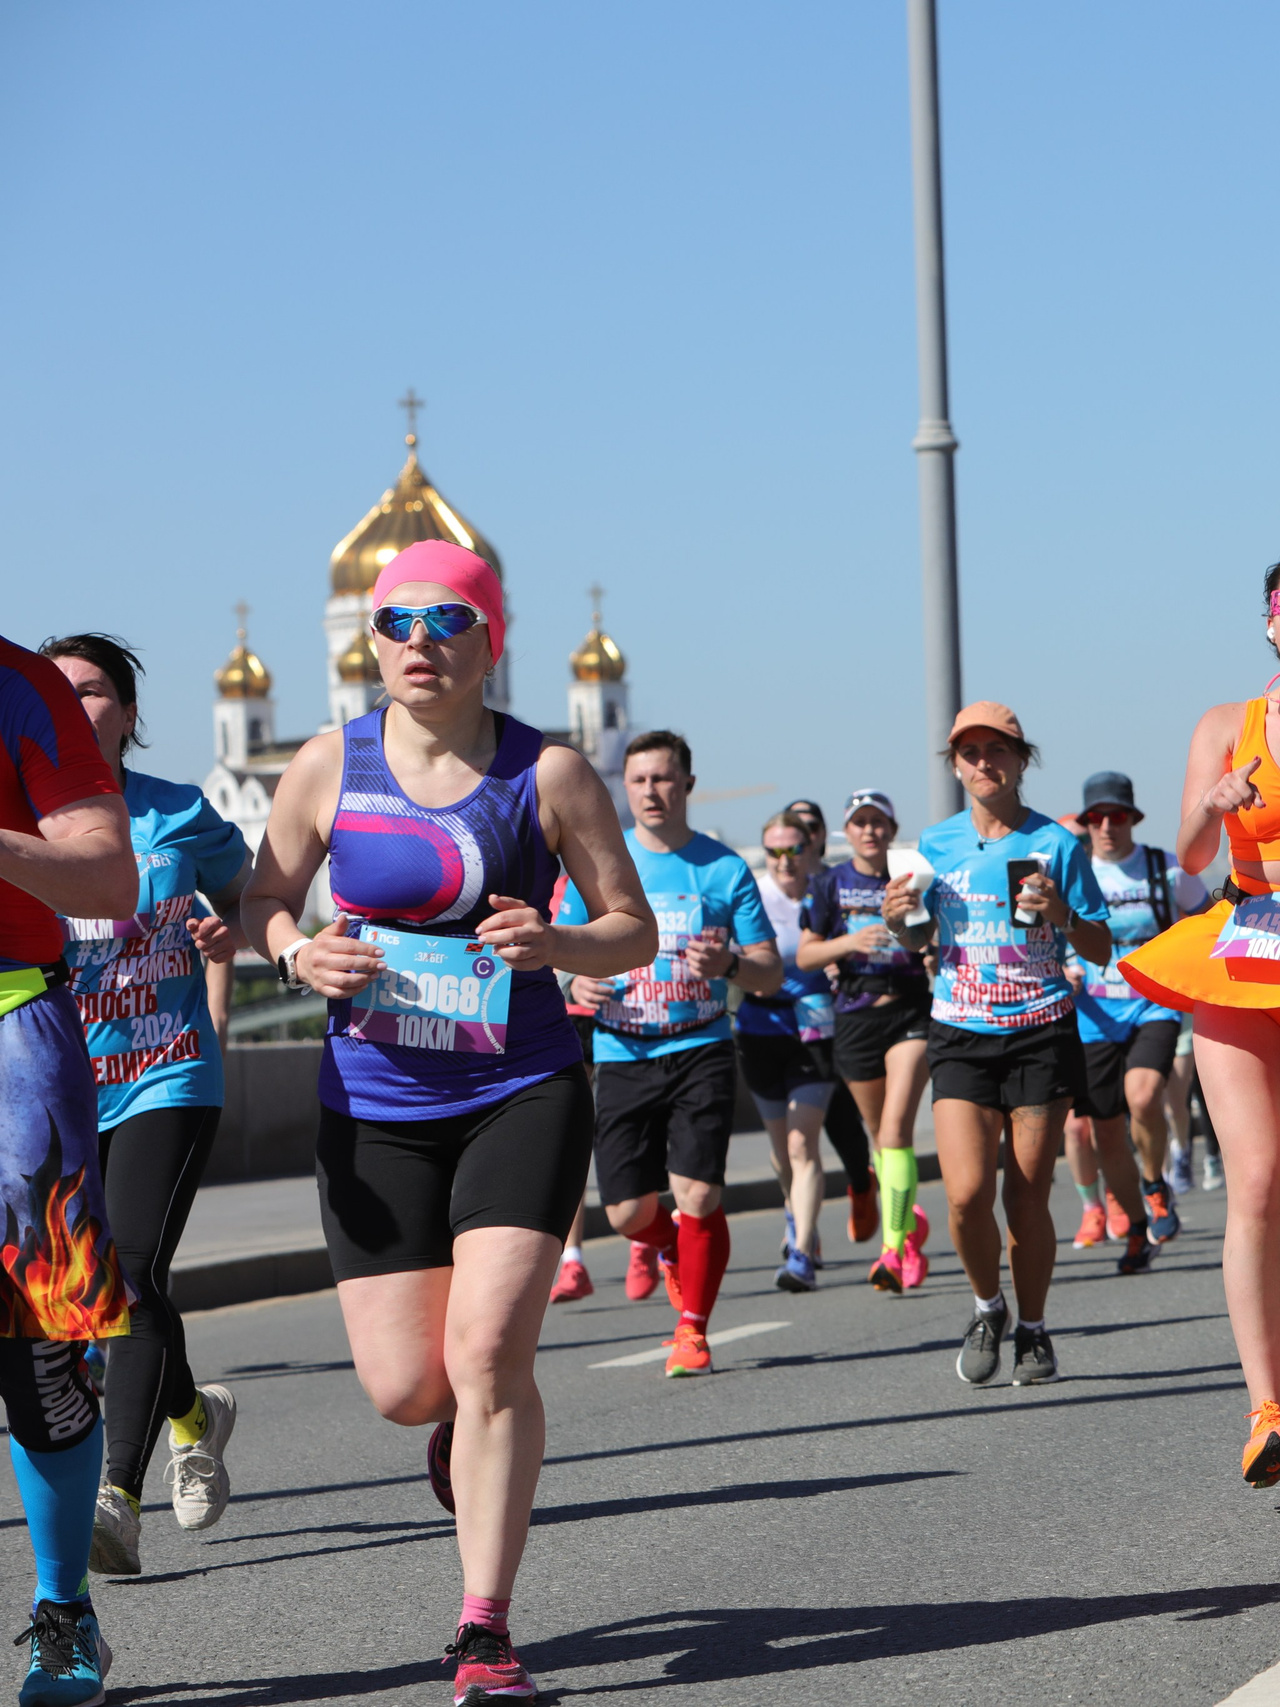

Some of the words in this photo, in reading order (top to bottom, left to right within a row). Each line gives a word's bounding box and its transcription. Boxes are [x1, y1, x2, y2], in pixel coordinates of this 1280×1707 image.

[66, 918, 114, 941] 10KM
[379, 933, 400, 945] ПСБ
[954, 920, 1009, 943] 32244
[966, 946, 1000, 964] 10KM
[476, 960, 490, 975] C
[379, 967, 481, 1016] 33068
[131, 1010, 183, 1050] 2024
[396, 1013, 457, 1051] 10KM
